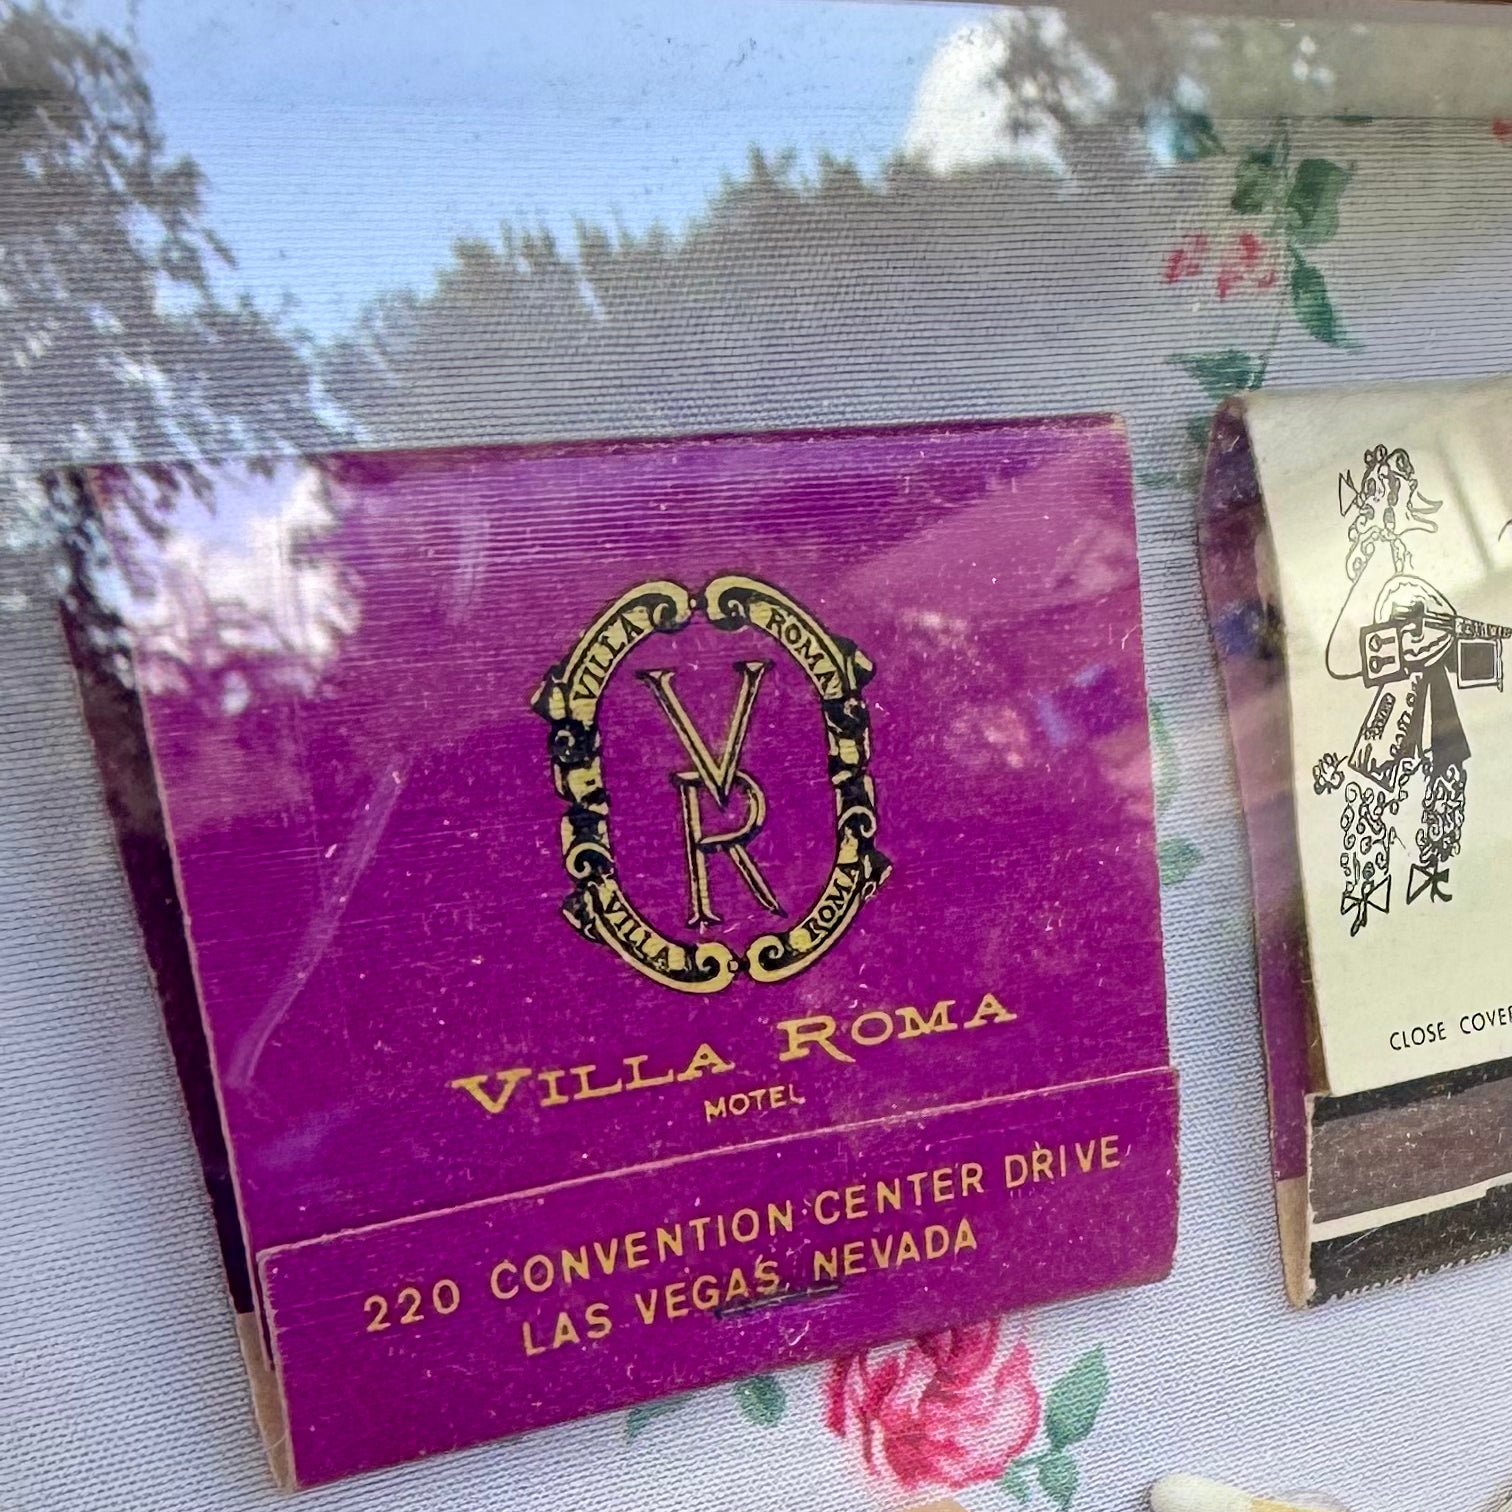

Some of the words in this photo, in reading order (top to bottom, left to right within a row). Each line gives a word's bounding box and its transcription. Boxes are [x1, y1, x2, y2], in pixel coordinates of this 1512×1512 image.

[451, 1043, 735, 1114] VILLA
[778, 992, 1017, 1064] ROMA
[1389, 1022, 1447, 1051] CLOSE
[704, 1085, 805, 1122] MOTEL
[363, 1278, 462, 1331] 220
[491, 1199, 794, 1299] CONVENTION
[813, 1162, 984, 1227] CENTER
[1005, 1136, 1123, 1189] DRIVE
[521, 1300, 612, 1356] LAS
[813, 1217, 979, 1280] NEVADA
